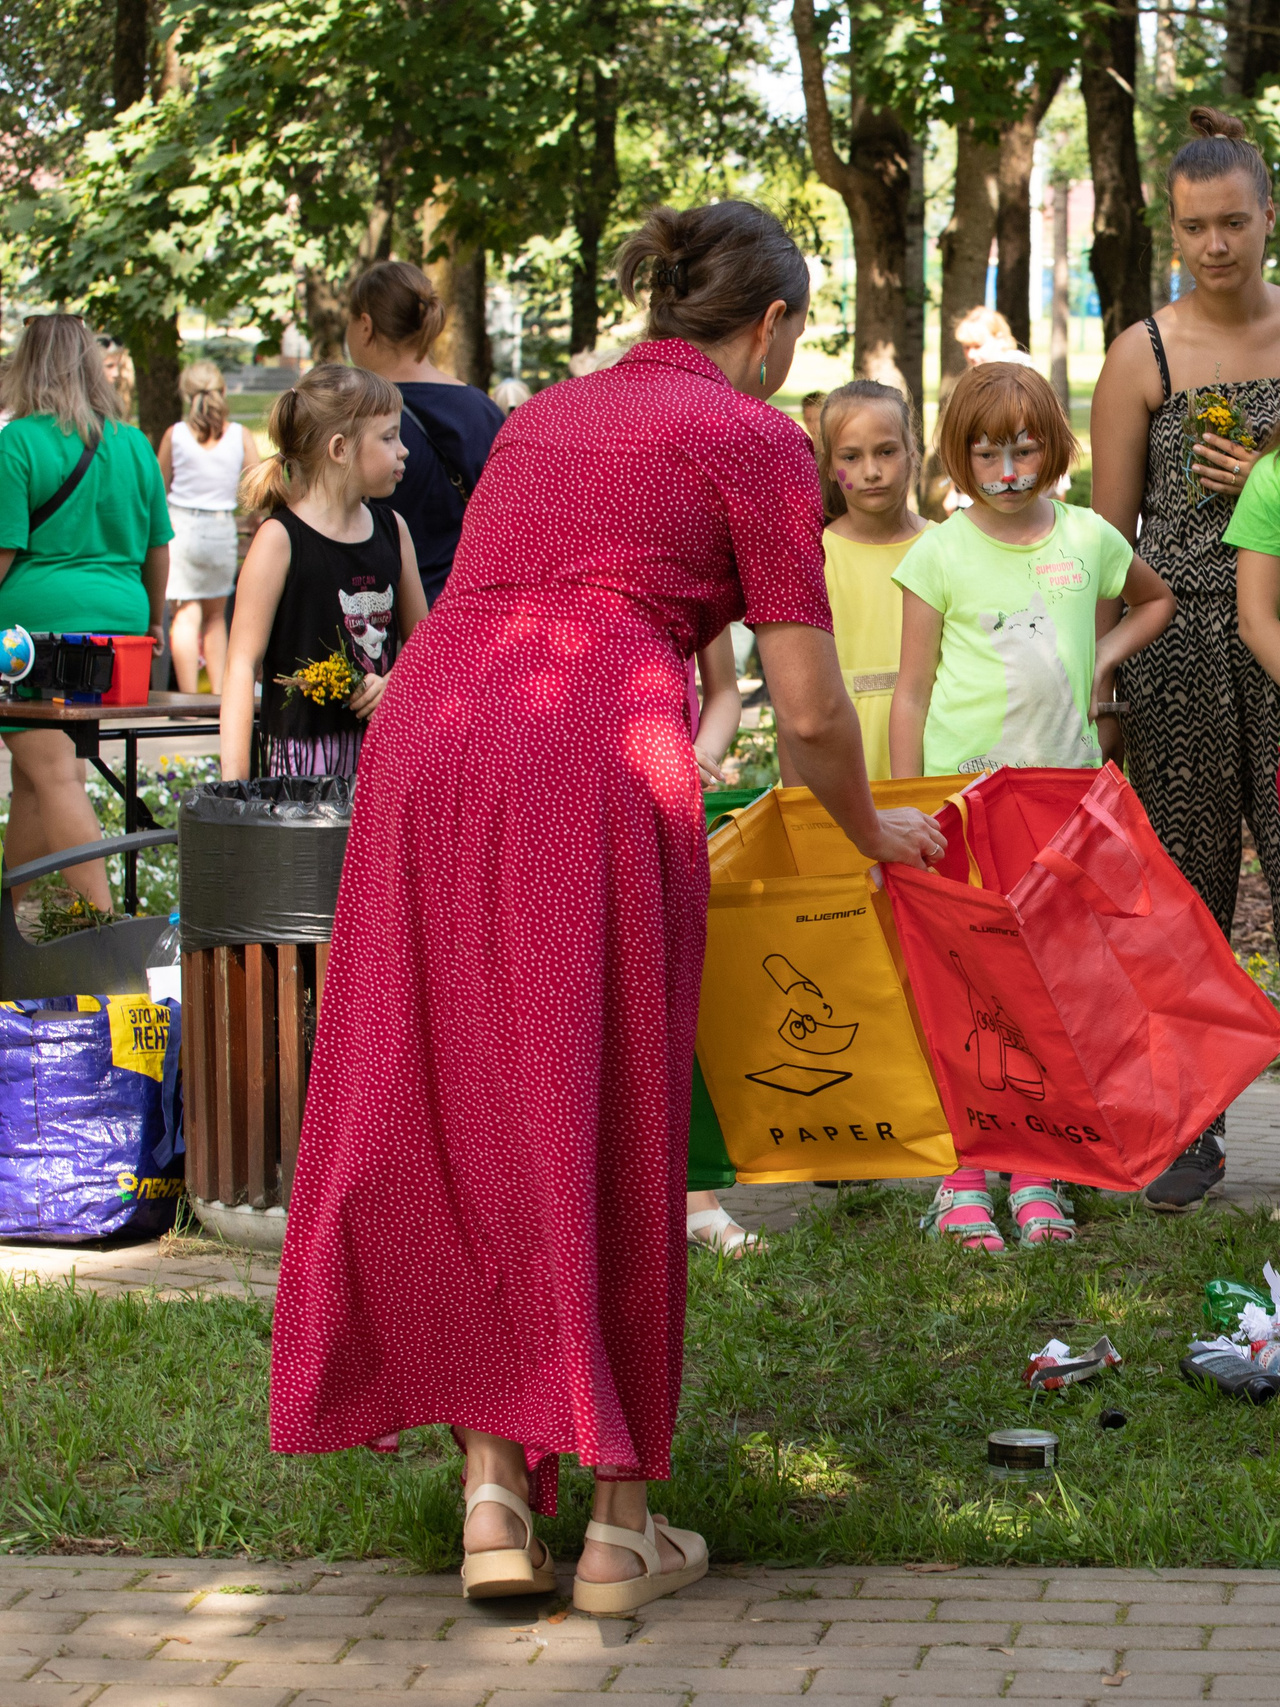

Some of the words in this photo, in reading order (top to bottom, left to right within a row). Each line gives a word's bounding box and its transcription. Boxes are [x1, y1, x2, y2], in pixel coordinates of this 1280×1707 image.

[1035, 560, 1074, 575] SUMBUDDY
[1049, 574, 1071, 586] PUSH
[1072, 573, 1082, 584] ME
[795, 907, 867, 923] BLUEMING
[969, 924, 1020, 937] BLUEMING
[128, 1008, 152, 1024] ЭТО
[155, 1008, 171, 1023] МО
[132, 1026, 170, 1051] ЛЕНТ
[769, 1121, 897, 1145] PAPER
[966, 1107, 1003, 1131] PET
[1025, 1114, 1102, 1144] GLASS
[136, 1177, 185, 1199] ЛЕНТА
